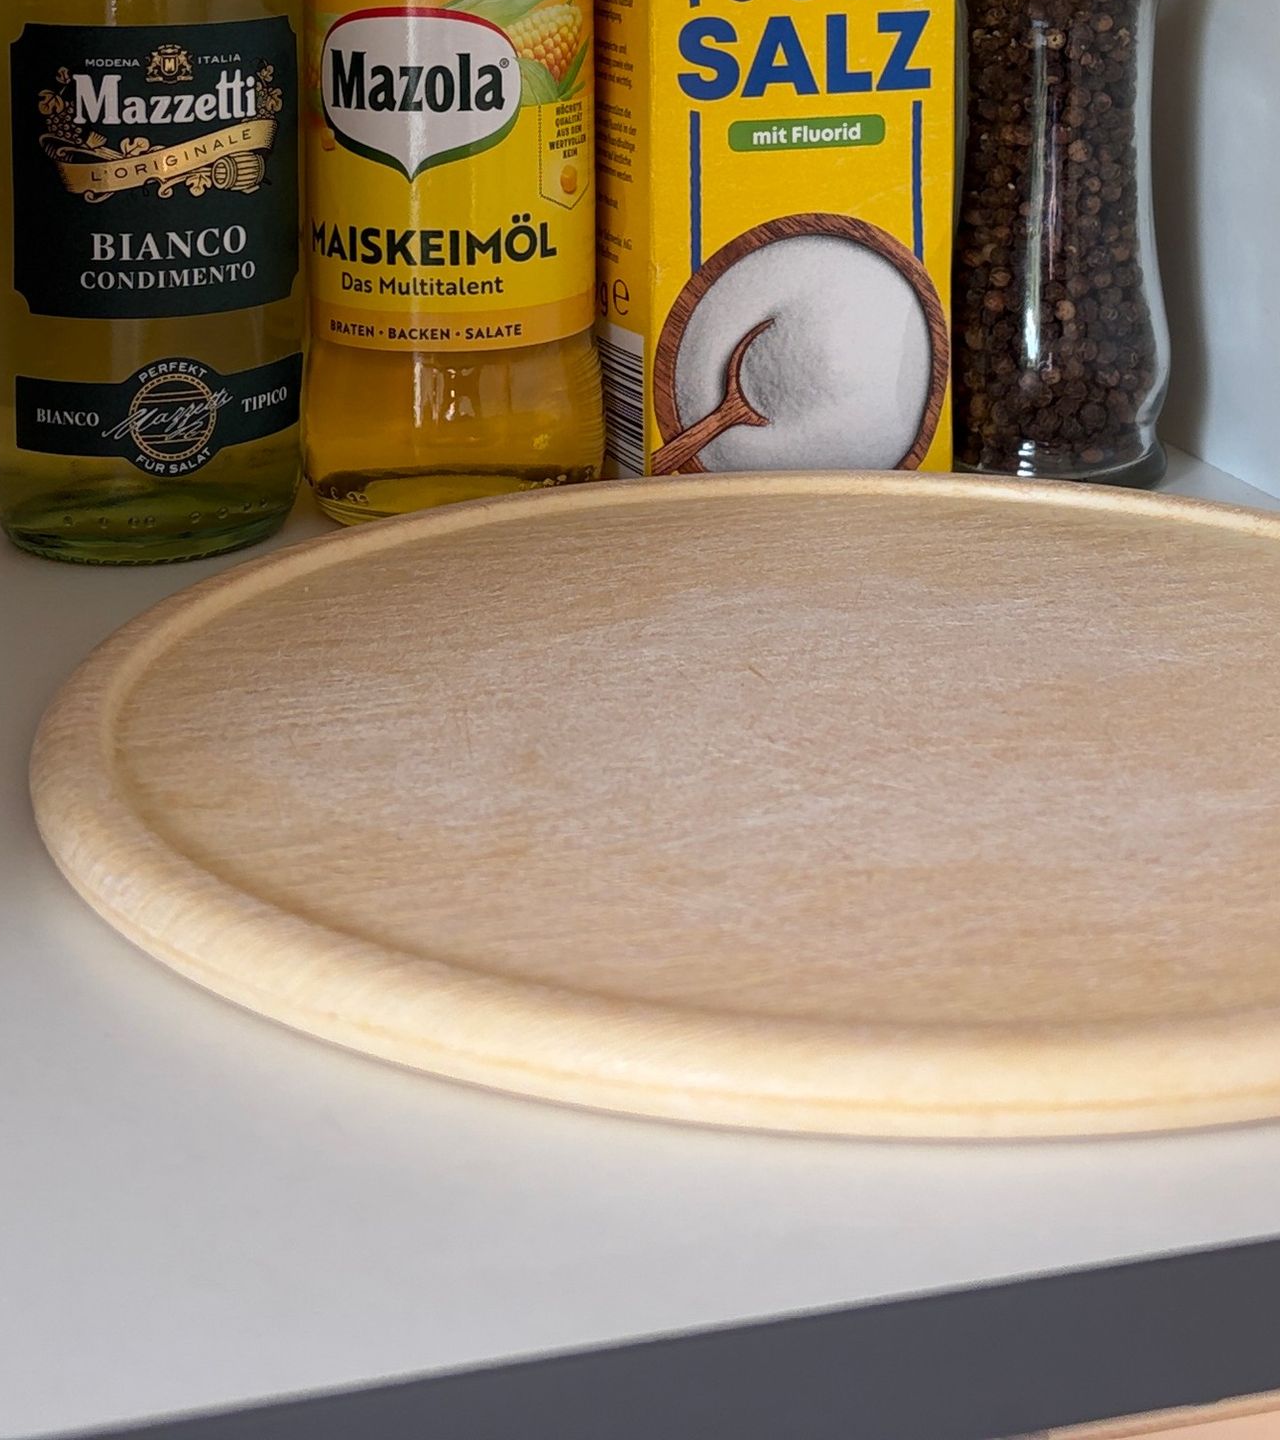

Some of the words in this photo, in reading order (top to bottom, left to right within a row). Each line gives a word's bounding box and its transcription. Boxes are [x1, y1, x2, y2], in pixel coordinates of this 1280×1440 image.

[85, 58, 140, 68] MODENA
[197, 53, 241, 64] ITALIA
[677, 10, 932, 101] SALZ
[73, 69, 257, 125] Mazzetti
[752, 125, 788, 146] mit
[791, 121, 862, 144] Fluorid
[90, 129, 252, 182] L'ORIGINALE
[90, 225, 247, 261] BIANCO
[312, 213, 557, 266] MAISKEIMÖL
[80, 260, 256, 290] CONDIMENTO
[341, 272, 373, 294] Das
[379, 276, 504, 297] Multitalent
[330, 319, 375, 337] BRATEN
[388, 327, 450, 341] BACKEN
[465, 323, 523, 340] SALATE
[138, 361, 209, 383] PERFEKT
[241, 386, 288, 412] TIPICO
[36, 408, 99, 427] BIANCO
[169, 446, 213, 474] SALAT
